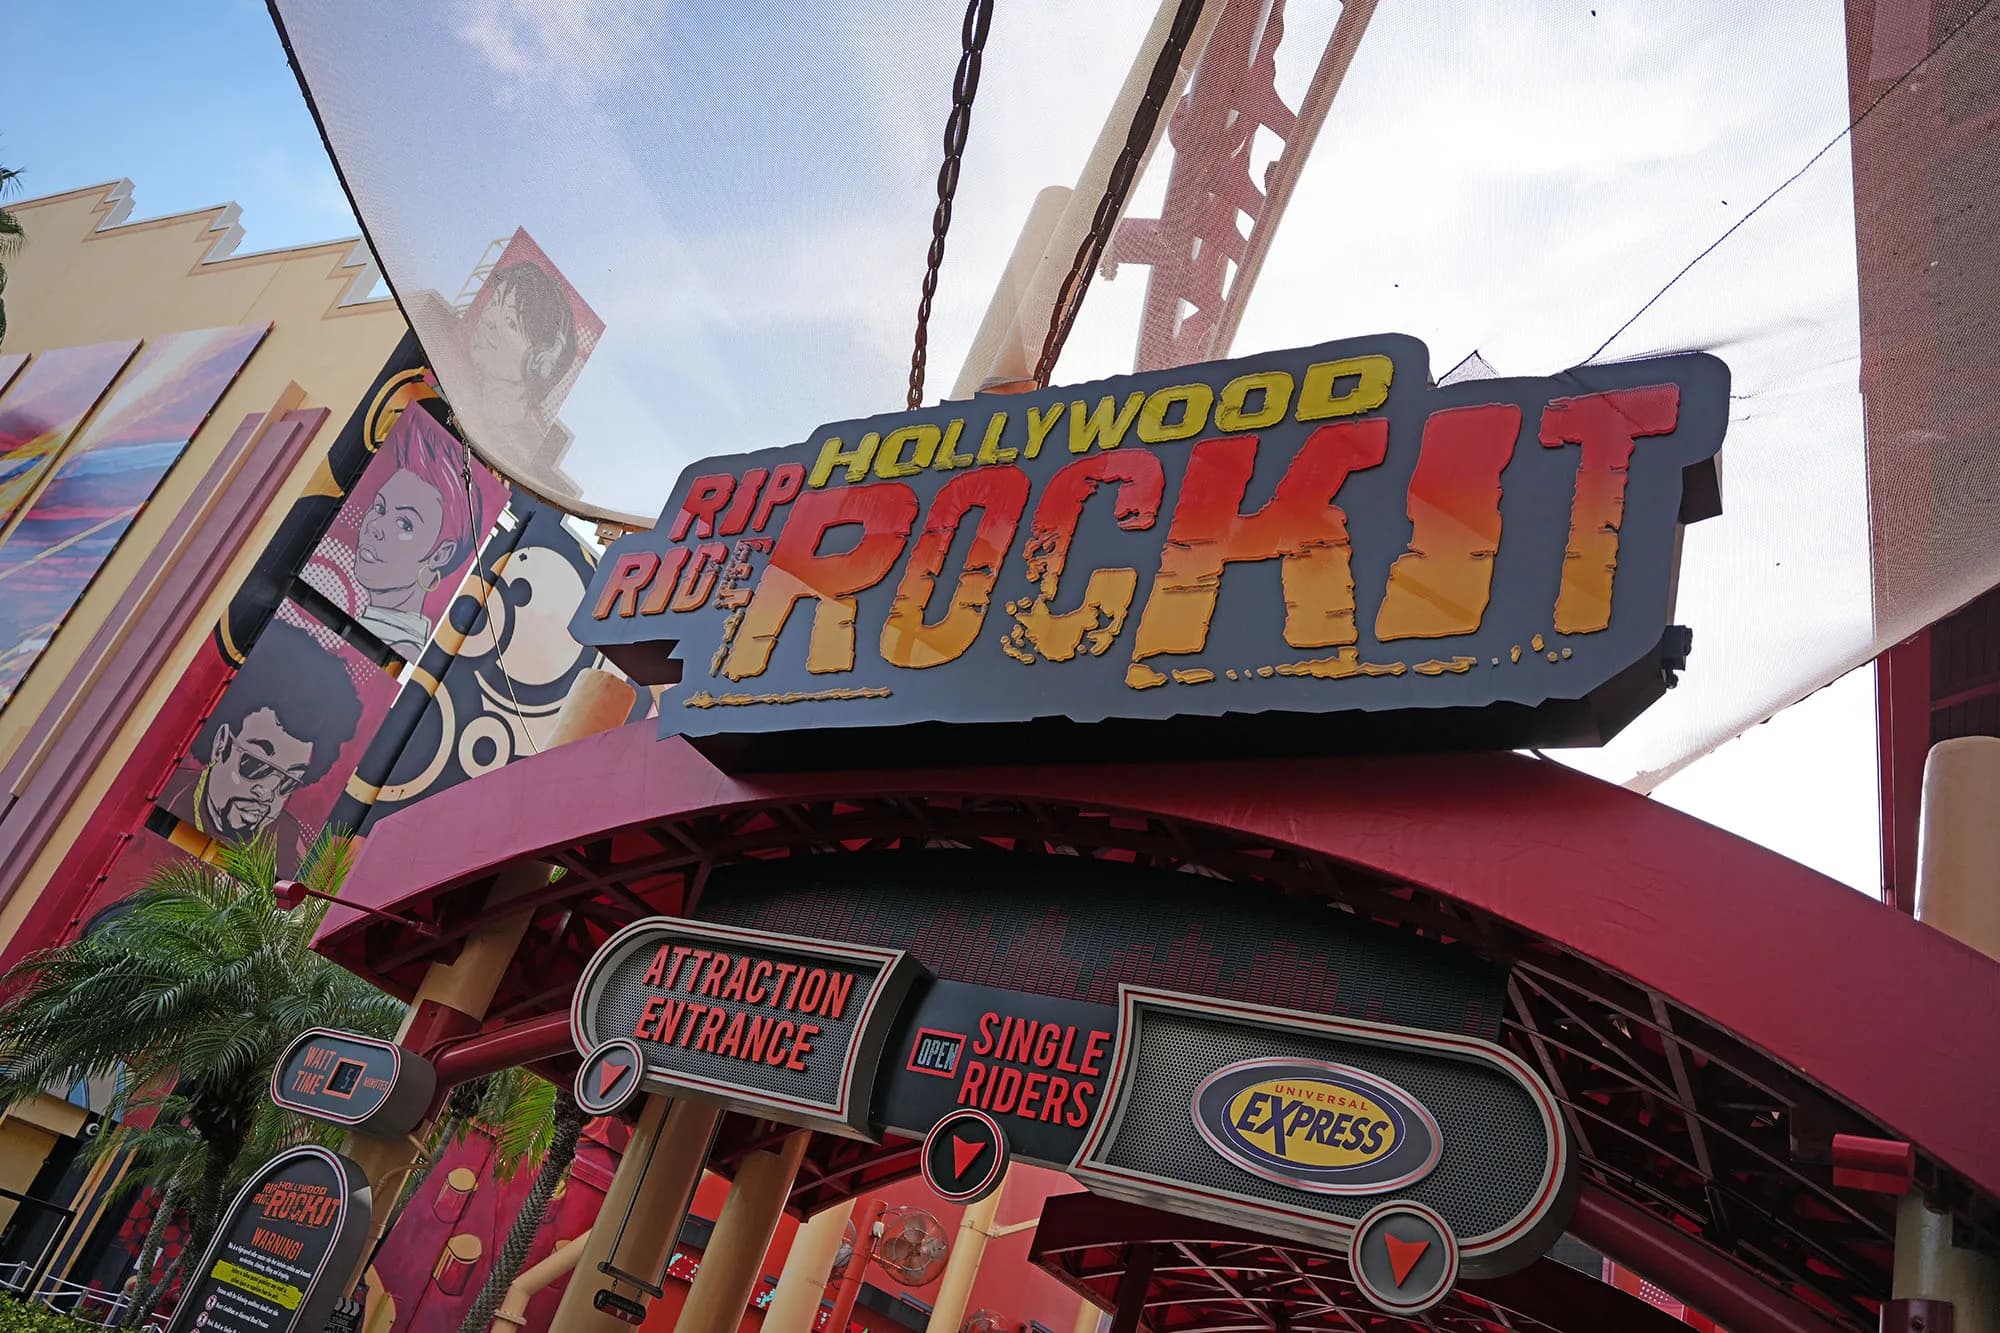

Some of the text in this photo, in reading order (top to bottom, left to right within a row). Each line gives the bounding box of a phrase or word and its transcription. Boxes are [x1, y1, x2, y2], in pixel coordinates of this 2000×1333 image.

[809, 354, 1394, 488] HOLLYWOOD
[669, 462, 807, 541] RIP
[722, 381, 1680, 683] ROCKIT
[592, 536, 774, 619] RIDE
[641, 944, 856, 1020] ATTRACTION
[303, 1046, 336, 1071] WAIT
[634, 995, 821, 1072] ENTRANCE
[917, 1038, 960, 1070] OPEN
[972, 1011, 1112, 1076] SINGLE
[291, 1070, 325, 1095] TIME
[362, 1076, 389, 1092] MINUTES
[956, 1062, 1097, 1128] RIDERS
[1274, 1083, 1370, 1112] UNIVERSAL
[1236, 1091, 1390, 1156] EXPRESS
[263, 1182, 279, 1194] RIP
[263, 1190, 341, 1228] ROCKIT
[278, 1180, 328, 1195] HOLLYWOOD
[250, 1227, 304, 1261] WARNING!
